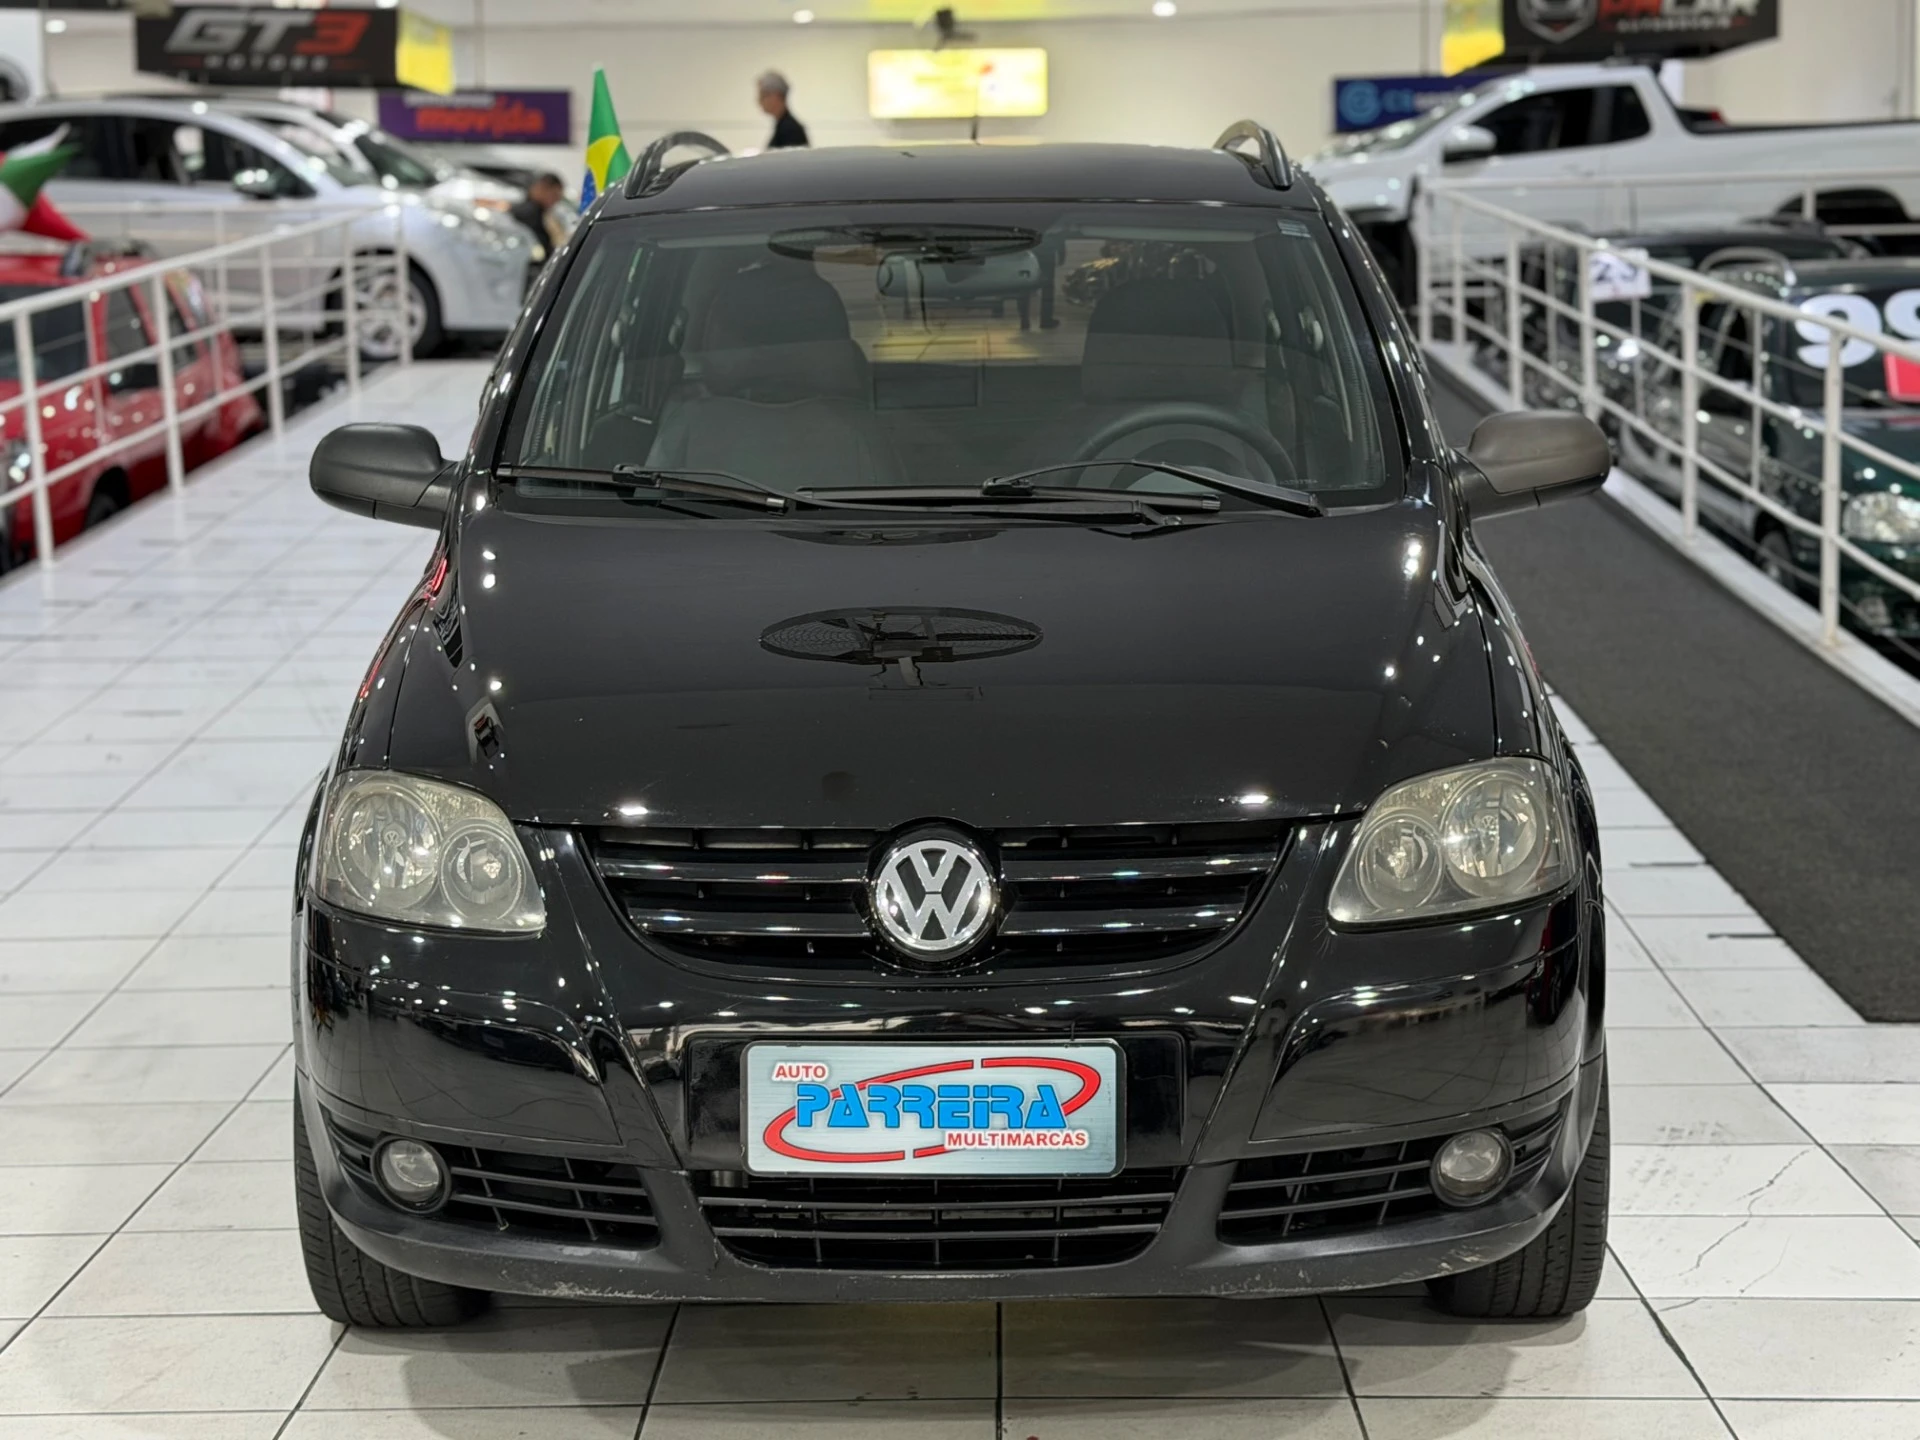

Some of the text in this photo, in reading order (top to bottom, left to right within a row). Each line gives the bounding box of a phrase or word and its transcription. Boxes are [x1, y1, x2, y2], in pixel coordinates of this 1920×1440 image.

[164, 9, 371, 55] GT3
[774, 1064, 827, 1080] AUTO
[796, 1083, 1068, 1129] PARREIRA
[946, 1131, 1087, 1147] MULTIMARCAS
